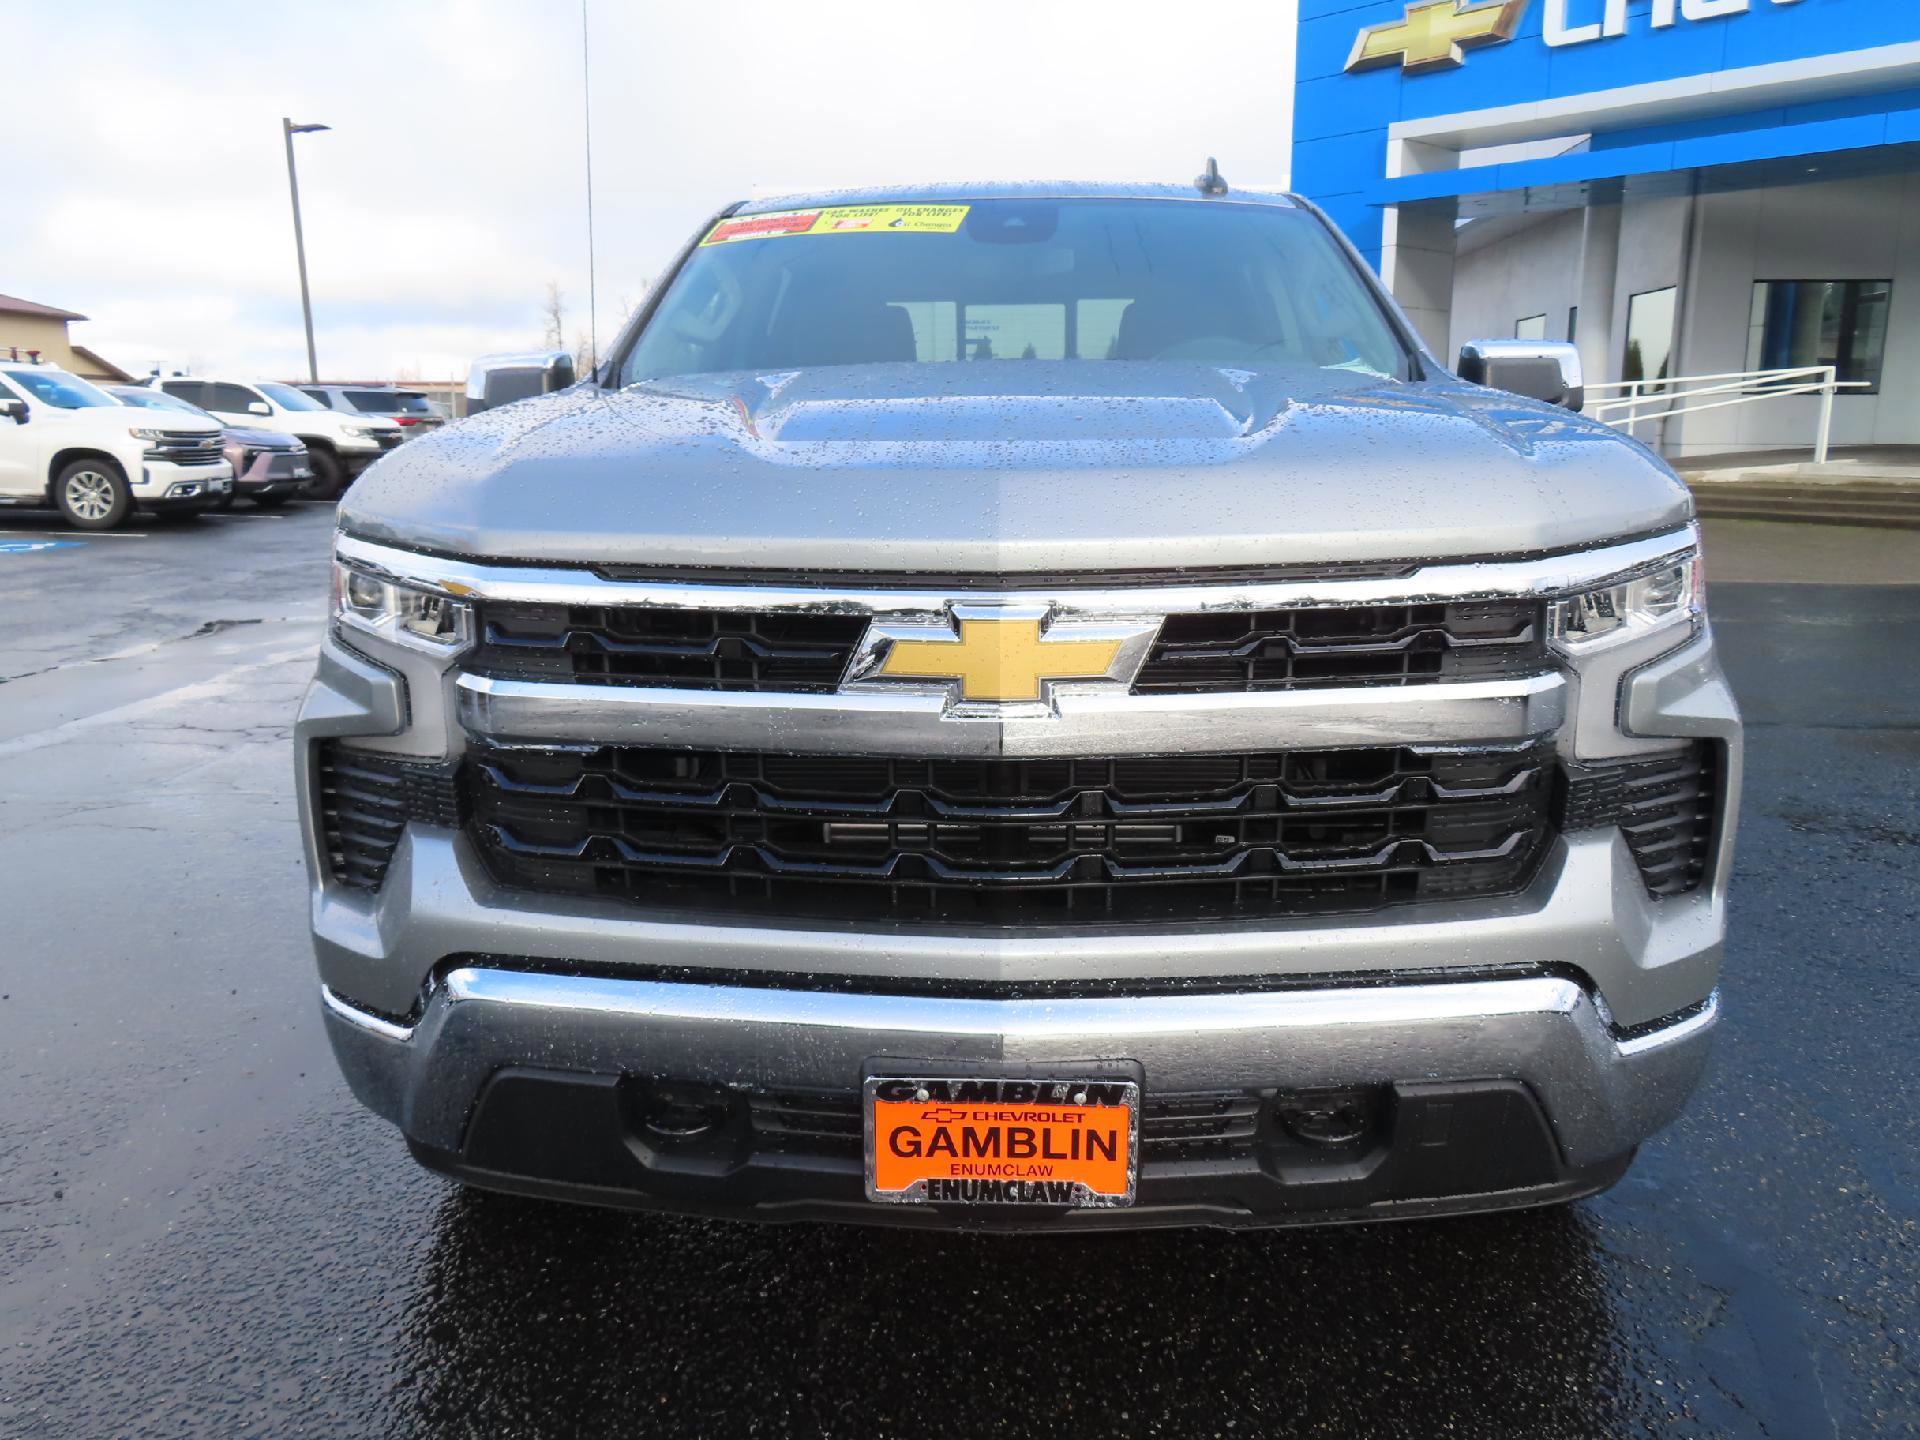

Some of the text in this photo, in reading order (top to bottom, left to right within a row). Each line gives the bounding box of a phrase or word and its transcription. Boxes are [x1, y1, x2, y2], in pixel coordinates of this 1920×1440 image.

[876, 1081, 1126, 1105] GAMBLIN
[972, 1111, 1086, 1123] CHEVROLET
[888, 1125, 1117, 1161] GAMBLIN
[950, 1163, 1054, 1176] ENUMCLAW
[927, 1178, 1075, 1201] ENUMCLAW
